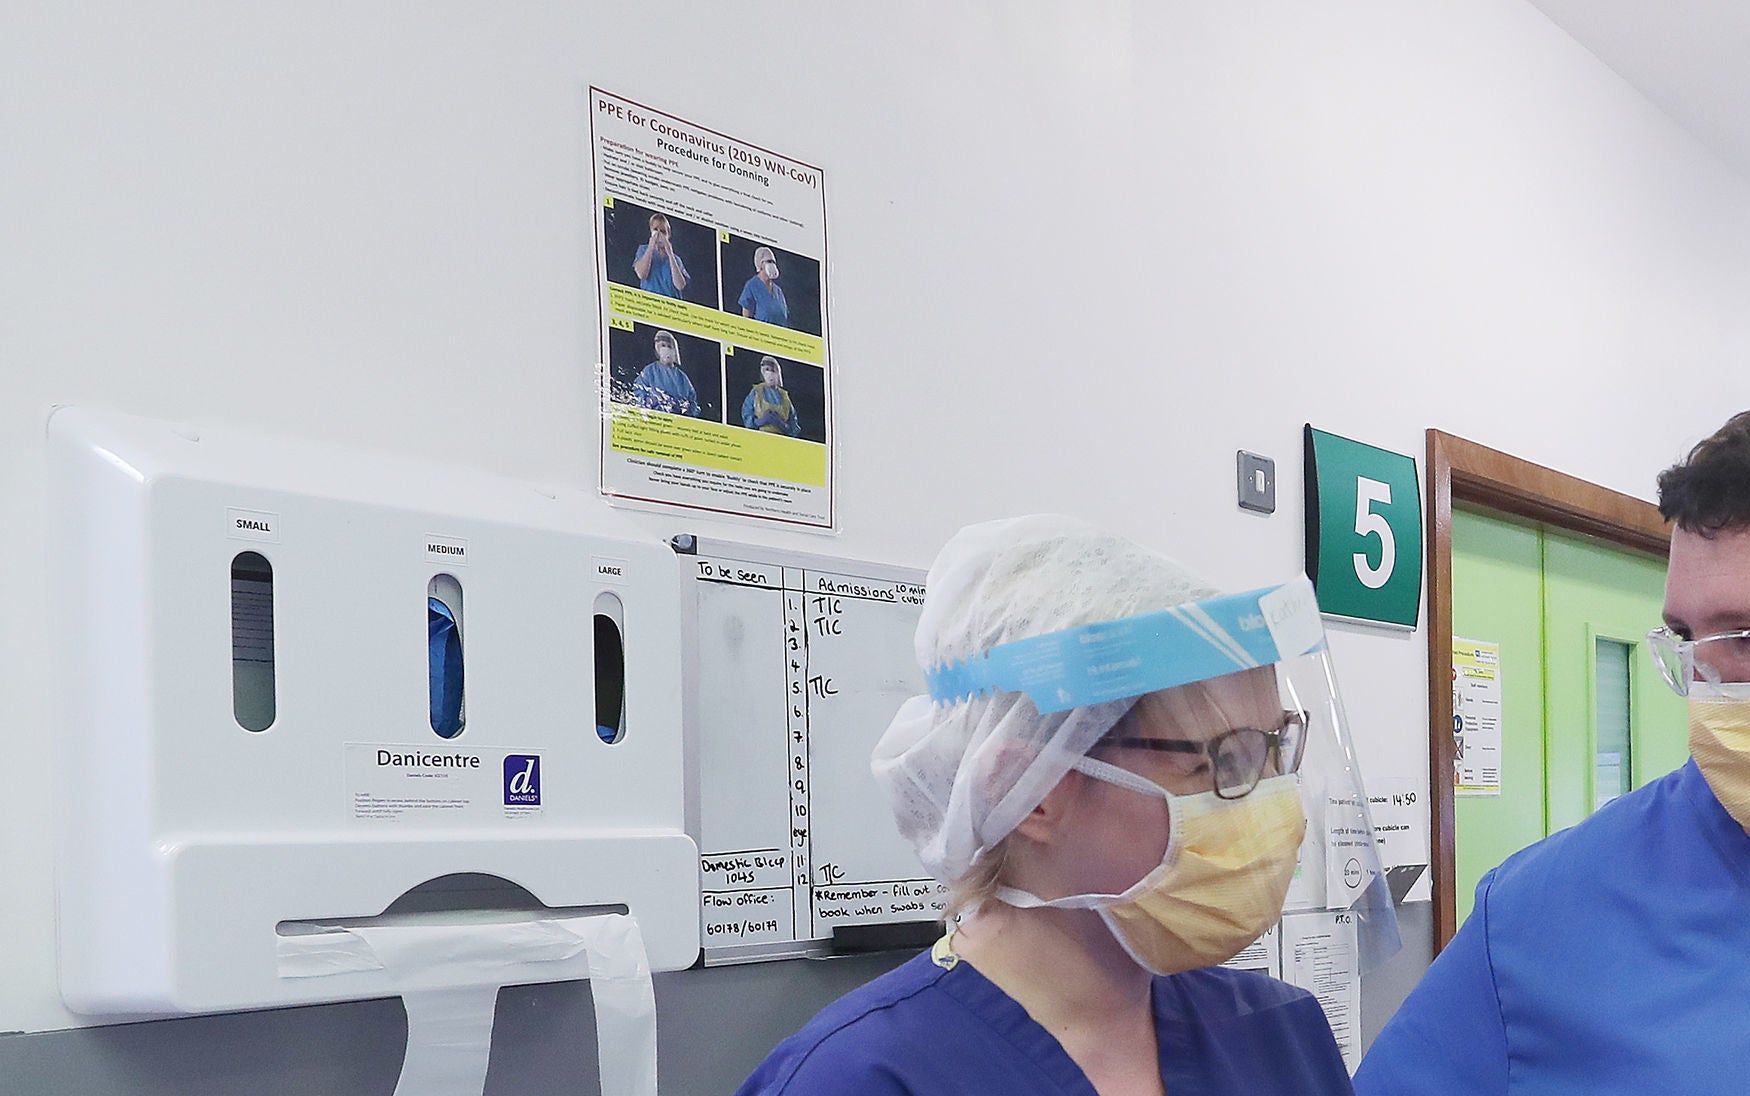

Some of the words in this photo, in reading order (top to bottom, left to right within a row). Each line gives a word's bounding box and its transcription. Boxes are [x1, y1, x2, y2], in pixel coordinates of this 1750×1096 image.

[599, 100, 623, 120] PPE
[627, 110, 646, 127] for
[650, 119, 725, 155] Coronavirus
[728, 145, 761, 167] (2019
[764, 158, 817, 189] WN-CoV)
[657, 138, 709, 165] Procedure
[712, 157, 726, 170] for
[729, 164, 770, 187] Donning
[236, 519, 271, 532] SMALL
[1353, 475, 1396, 589] 5
[427, 544, 465, 557] MEDIUM
[598, 566, 622, 577] LARGE
[697, 562, 712, 576] To
[718, 565, 732, 579] be
[737, 570, 767, 584] seen
[818, 578, 895, 600] Admissions
[791, 660, 800, 671] 4
[377, 750, 480, 768] Danicentre
[795, 757, 805, 770] 8
[1392, 792, 1417, 806] 14:50
[795, 805, 806, 816] 10
[702, 859, 752, 872] Domestic
[754, 857, 785, 869] Bleep
[726, 871, 755, 884] 1045
[797, 875, 808, 885] 12
[893, 885, 910, 897] fill
[914, 885, 930, 896] out
[703, 894, 732, 907] Flow
[819, 908, 849, 918] book
[855, 906, 882, 915] when
